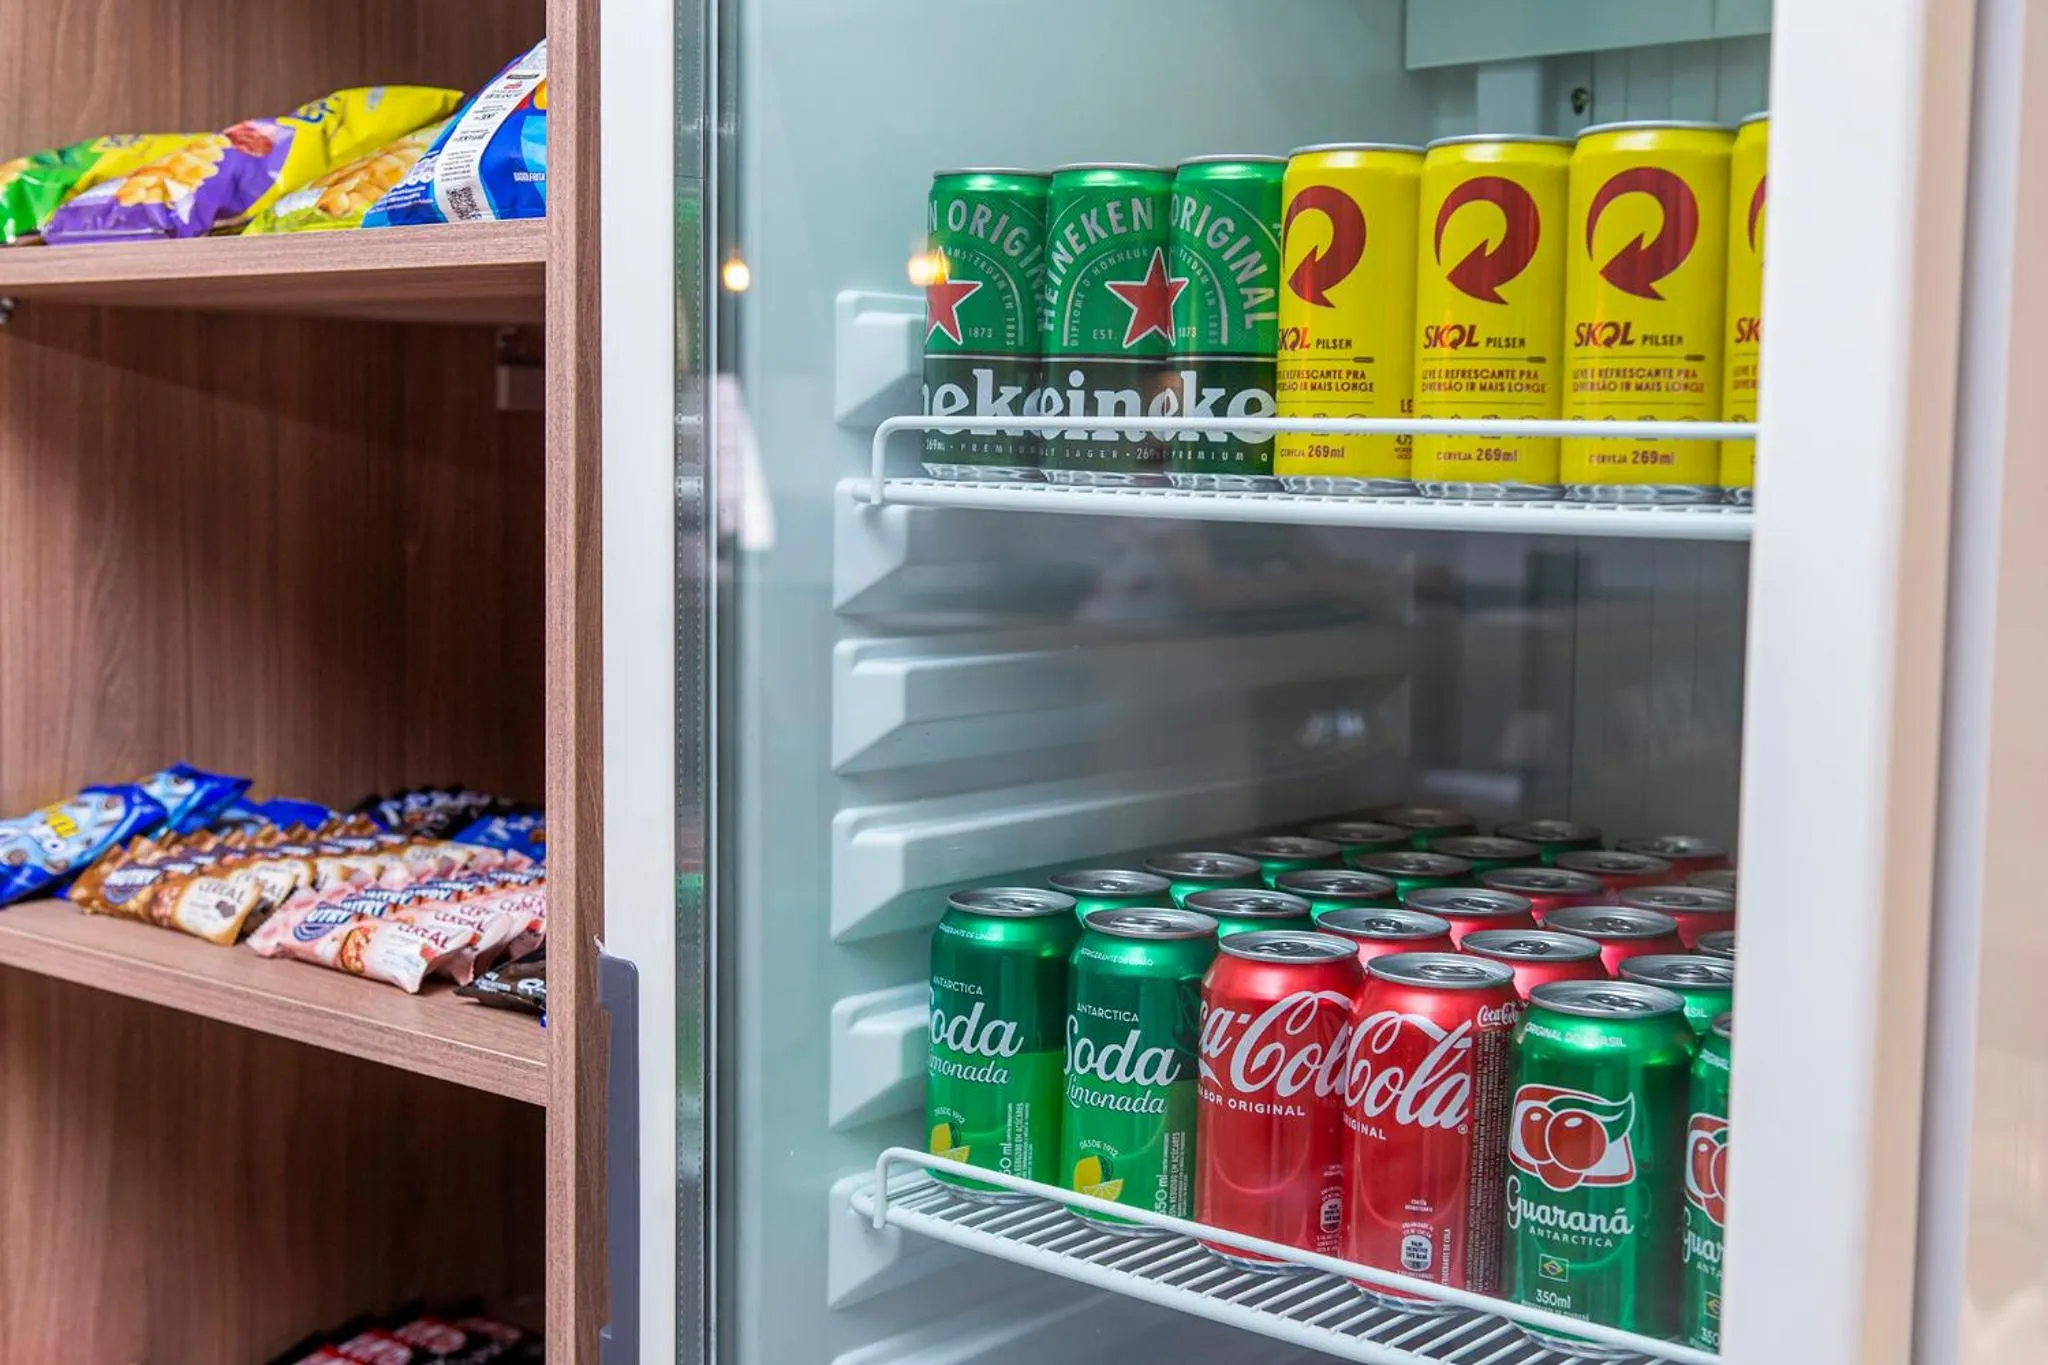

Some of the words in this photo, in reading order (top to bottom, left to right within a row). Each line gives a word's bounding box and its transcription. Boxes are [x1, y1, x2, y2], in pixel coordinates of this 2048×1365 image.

[1044, 197, 1153, 331] HEINEKEN
[1170, 193, 1278, 329] ORIGINAL
[968, 327, 993, 339] 1873
[1424, 323, 1479, 350] SKOL
[1486, 337, 1526, 349] PILSEN
[1574, 321, 1636, 348] SKOL
[1641, 334, 1683, 346] PILSEN
[1735, 316, 1762, 345] SK
[1316, 338, 1352, 349] PILSEN
[1346, 369, 1366, 380] PRA
[1445, 368, 1516, 380] REFRESCANTE
[1519, 369, 1539, 380] PRA
[1598, 367, 1673, 379] REFRESCANTE
[1676, 368, 1697, 379] PRA
[1310, 382, 1332, 392] MAIS
[1335, 382, 1374, 392] LONGE
[1466, 382, 1476, 392] IR
[1480, 382, 1505, 392] MAIS
[1508, 382, 1546, 393] LONGE
[1635, 382, 1662, 392] MAIS
[1665, 382, 1705, 393] LONGE
[1308, 444, 1345, 458] 269ml
[1476, 447, 1518, 462] 269ml
[1632, 450, 1675, 465] 269ml
[1077, 1002, 1140, 1023] ANTARCTICA
[1064, 1014, 1182, 1087] Soda
[1228, 1098, 1305, 1117] ORIGINAL
[1507, 1175, 1635, 1235] Guaraná
[1529, 1226, 1613, 1248] ANTARCTICA
[1535, 1288, 1572, 1309] 350ml
